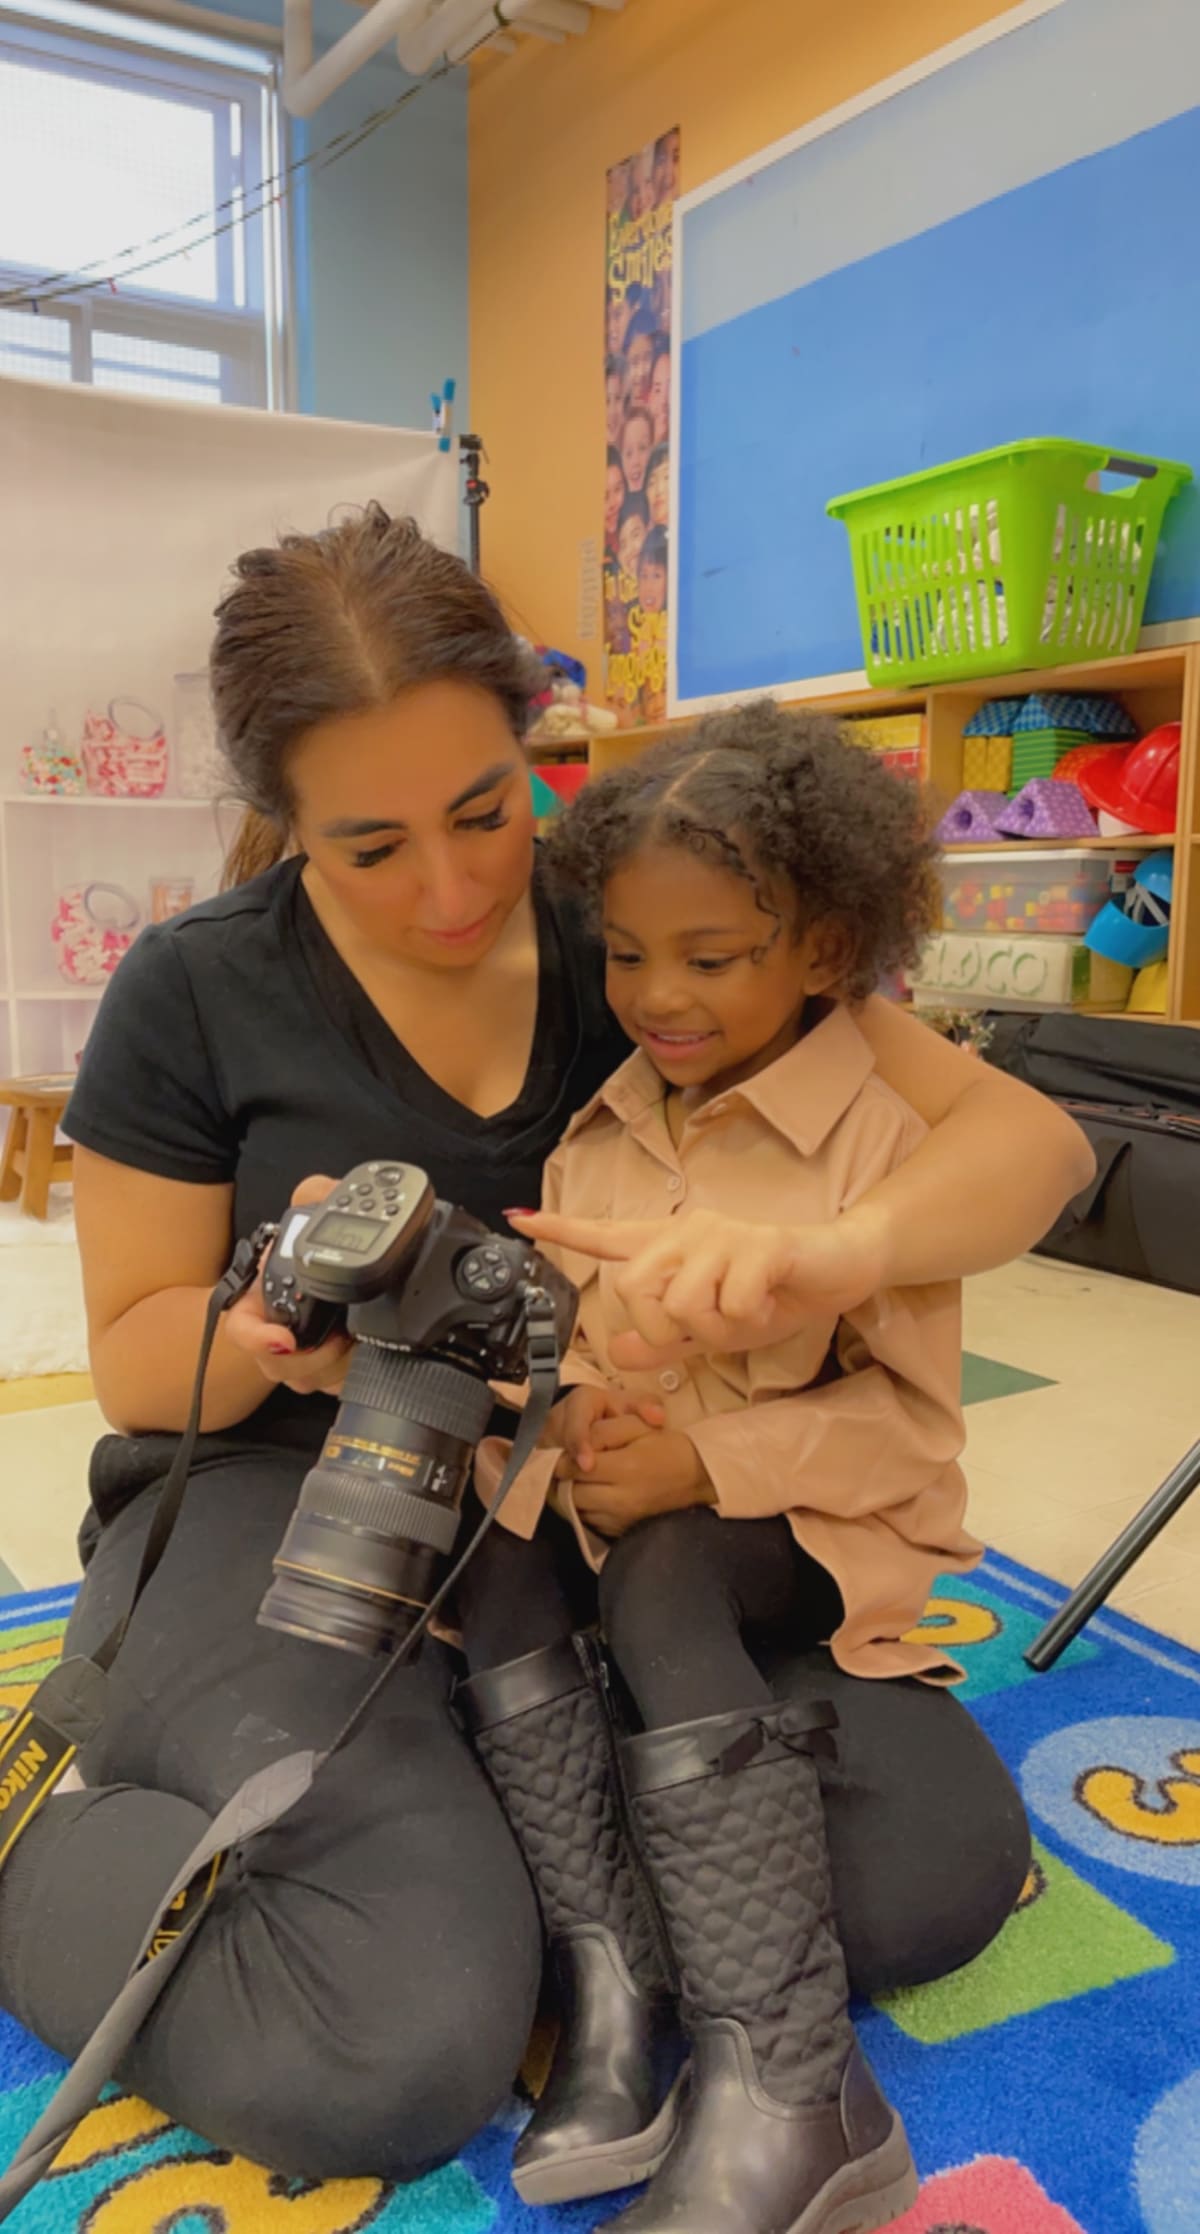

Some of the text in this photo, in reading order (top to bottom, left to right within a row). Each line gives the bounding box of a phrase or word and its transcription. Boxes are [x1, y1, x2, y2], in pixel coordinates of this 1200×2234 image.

[608, 199, 673, 256] Everyone
[608, 234, 673, 303] Smiles
[628, 604, 668, 647] Same
